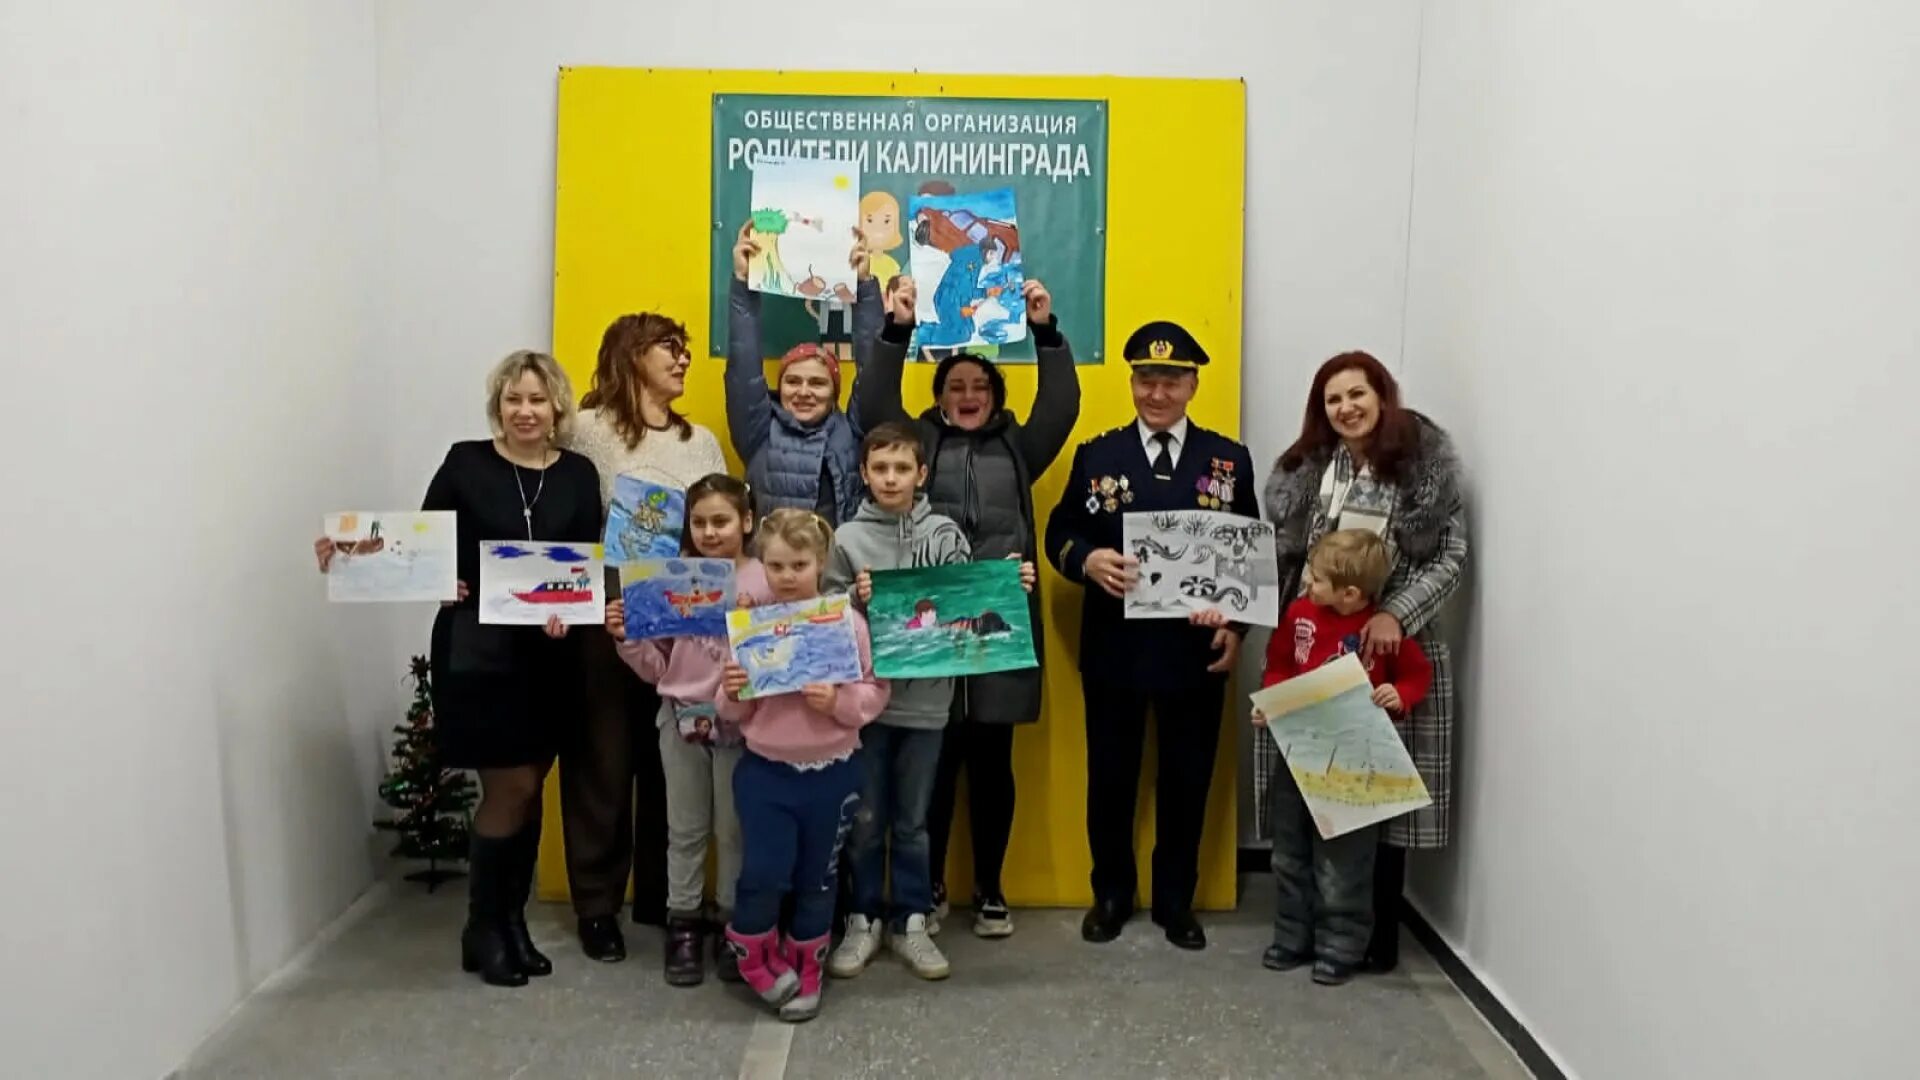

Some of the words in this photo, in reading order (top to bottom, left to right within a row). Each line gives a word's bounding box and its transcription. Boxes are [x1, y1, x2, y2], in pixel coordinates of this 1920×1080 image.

[744, 110, 914, 132] ОБЩЕСТВЕННАЯ
[925, 113, 1077, 138] ОРГАНИЗАЦИЯ
[877, 140, 1091, 183] КАЛИНИНГРАДА
